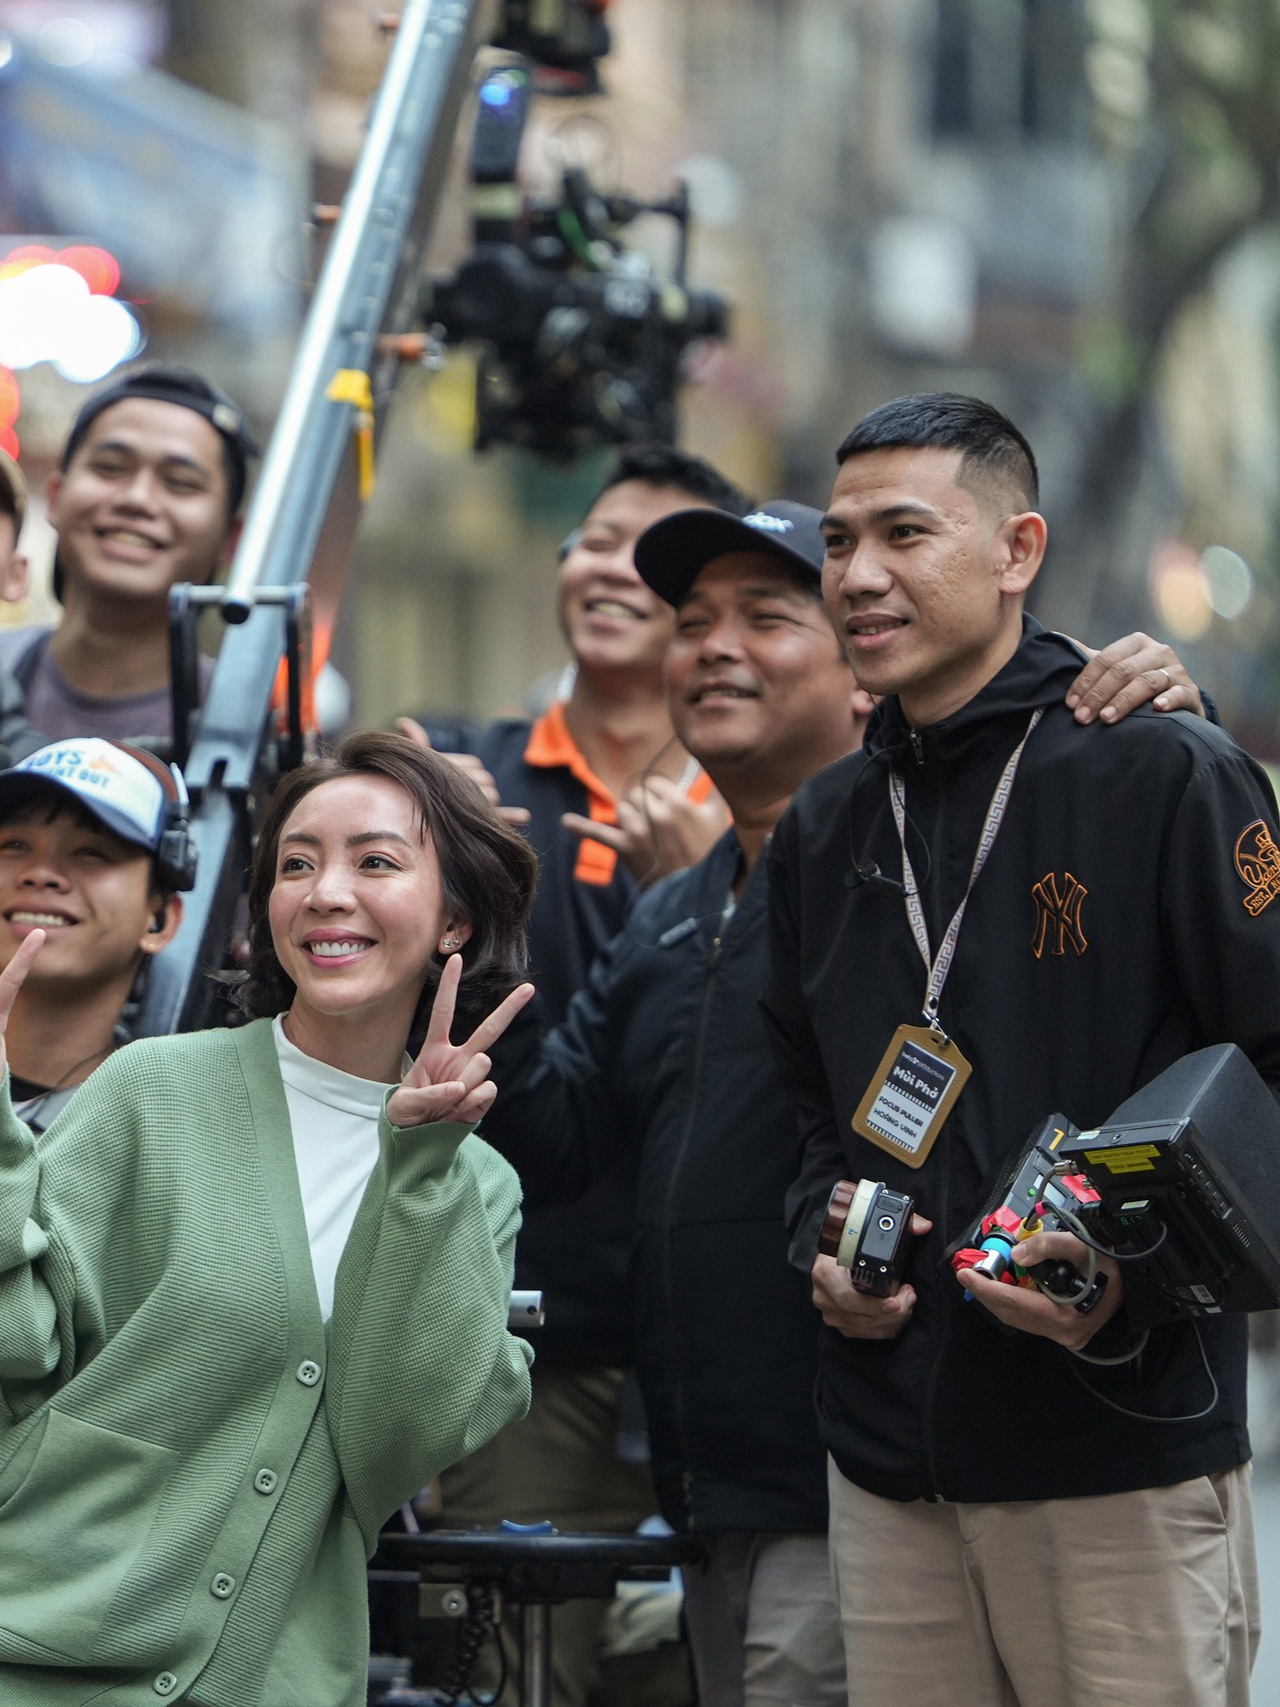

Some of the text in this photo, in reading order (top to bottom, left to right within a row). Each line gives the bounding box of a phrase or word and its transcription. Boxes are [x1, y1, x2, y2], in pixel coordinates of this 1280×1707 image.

[893, 1066, 939, 1099] Mùi Phở
[879, 1096, 923, 1128] FOCUS PULLER
[900, 1124, 917, 1138] VINH
